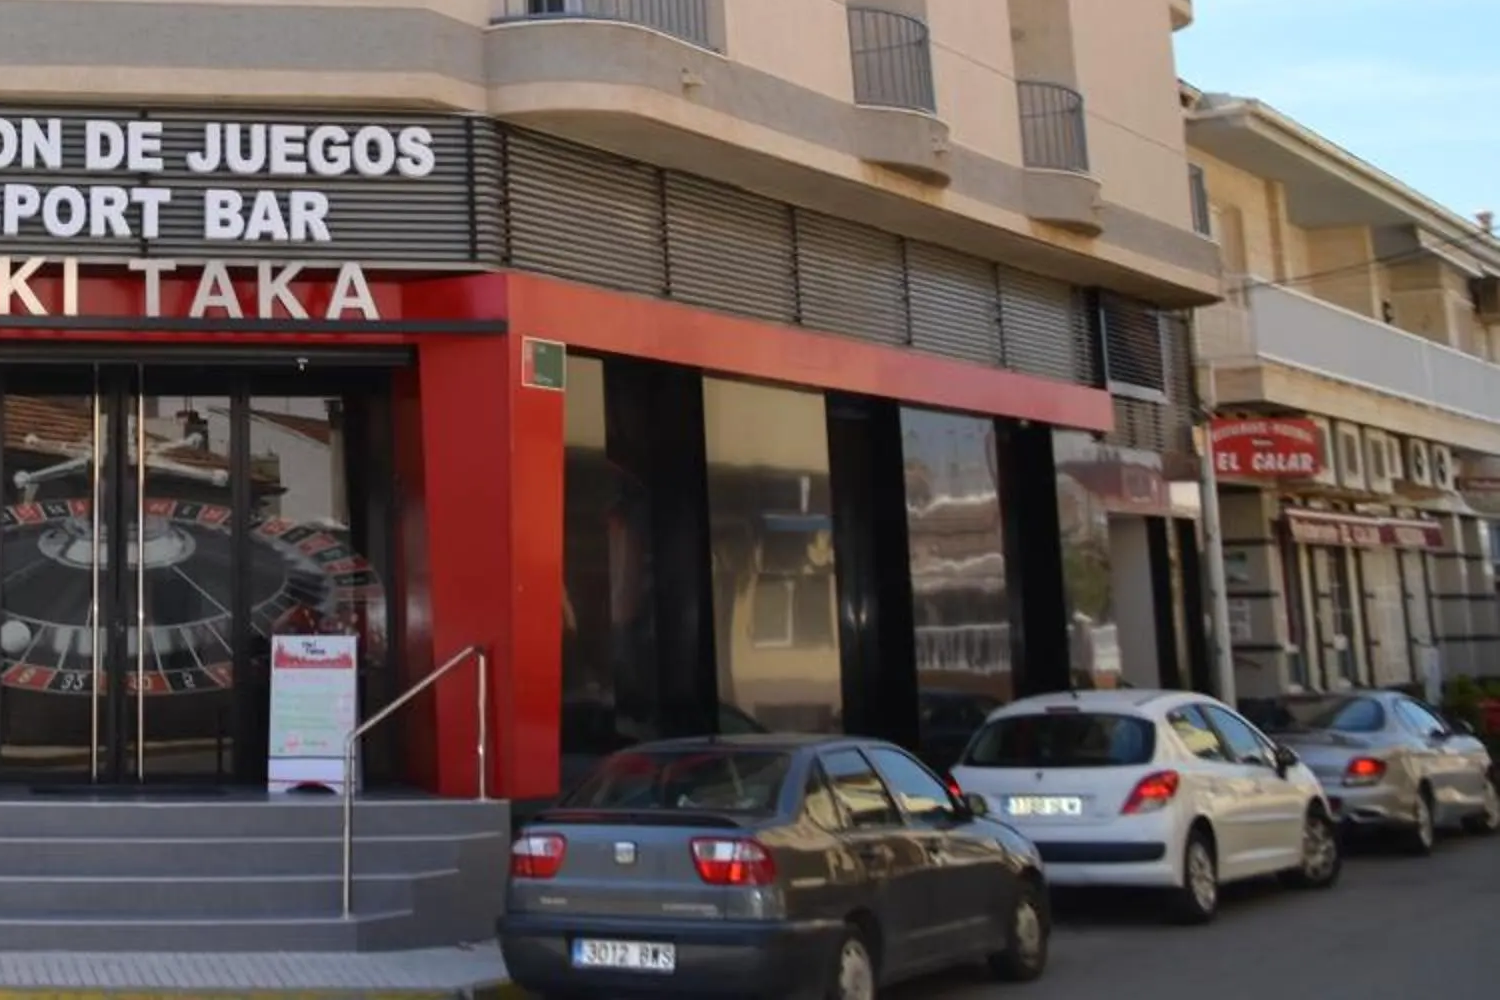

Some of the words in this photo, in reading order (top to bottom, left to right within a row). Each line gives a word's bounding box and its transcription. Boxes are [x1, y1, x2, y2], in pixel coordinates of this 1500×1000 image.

[85, 119, 164, 173] DE
[186, 122, 435, 178] JUEGOS
[204, 189, 332, 242] BAR
[128, 258, 380, 321] TAKA
